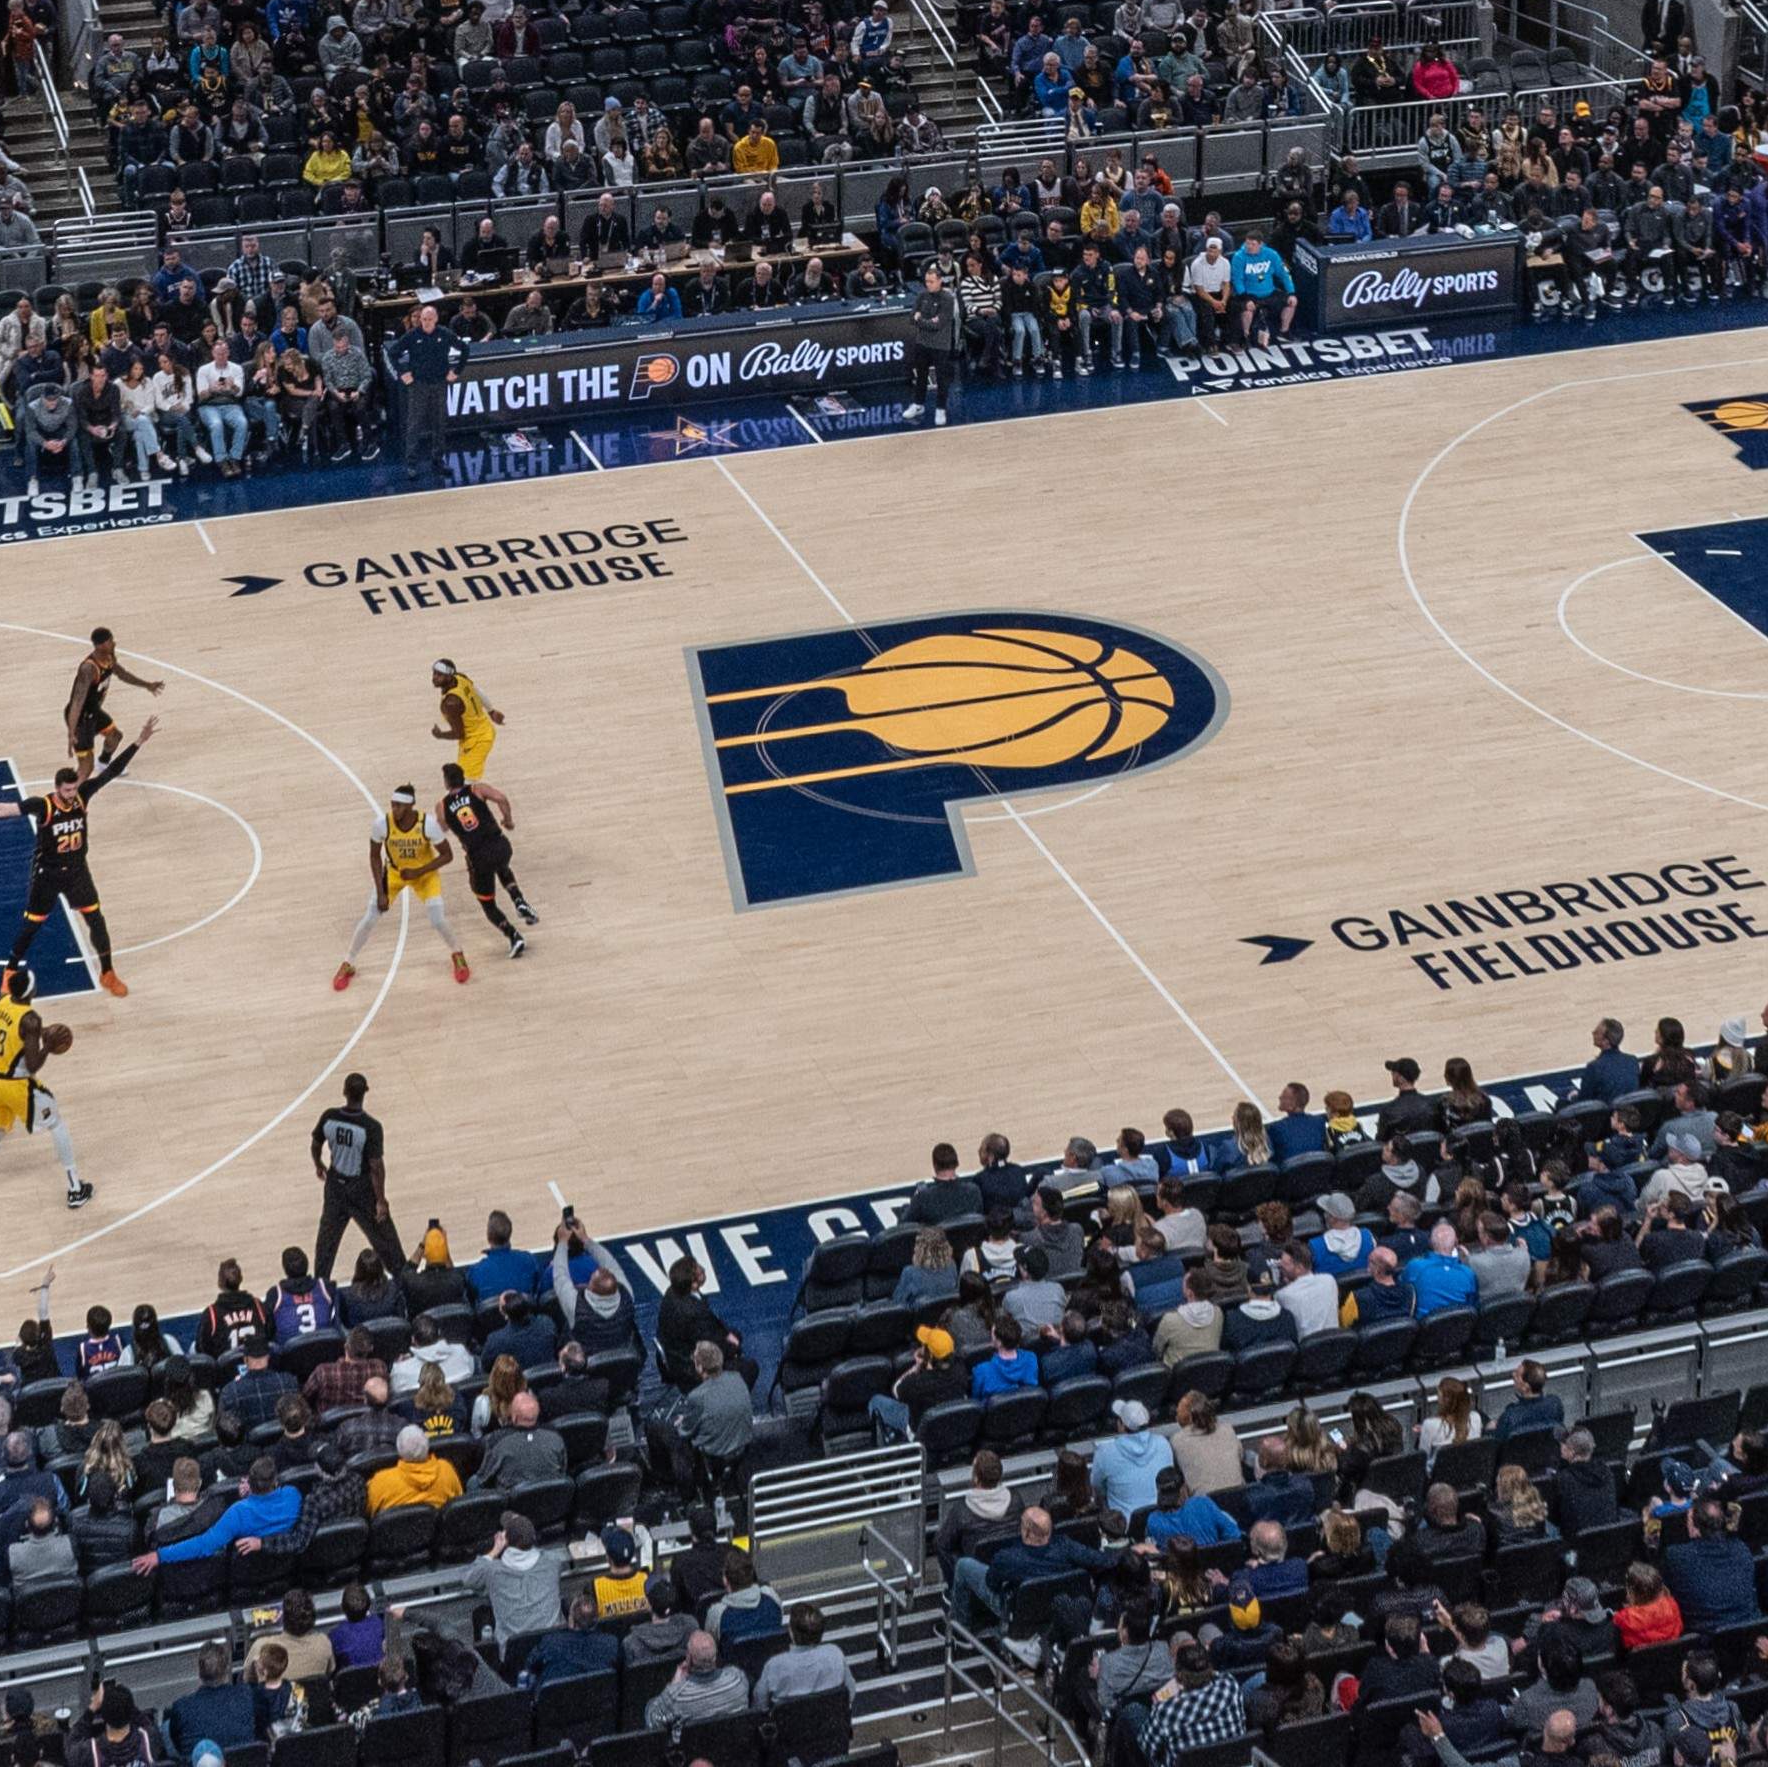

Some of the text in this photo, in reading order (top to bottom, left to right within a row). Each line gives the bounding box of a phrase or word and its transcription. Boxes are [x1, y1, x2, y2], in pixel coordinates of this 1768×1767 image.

[1245, 260, 1271, 274] INDY
[1342, 268, 1498, 308] Bally SPORTS
[1165, 327, 1434, 381] POINTSBET
[558, 364, 619, 402] THE
[687, 352, 730, 388] ON
[740, 339, 834, 380] Bally
[835, 340, 904, 367] SPORTS
[1240, 357, 1452, 388] Fanatics Experience
[38, 514, 173, 537] Experience
[303, 518, 688, 588] GAINBRIDGE
[361, 552, 674, 615] FIELDHOUSE
[52, 817, 84, 835] PHX
[456, 807, 479, 831] 8
[57, 834, 83, 852] 20
[1331, 855, 1766, 951] GAINBRIDGE
[297, 1304, 316, 1332] 3
